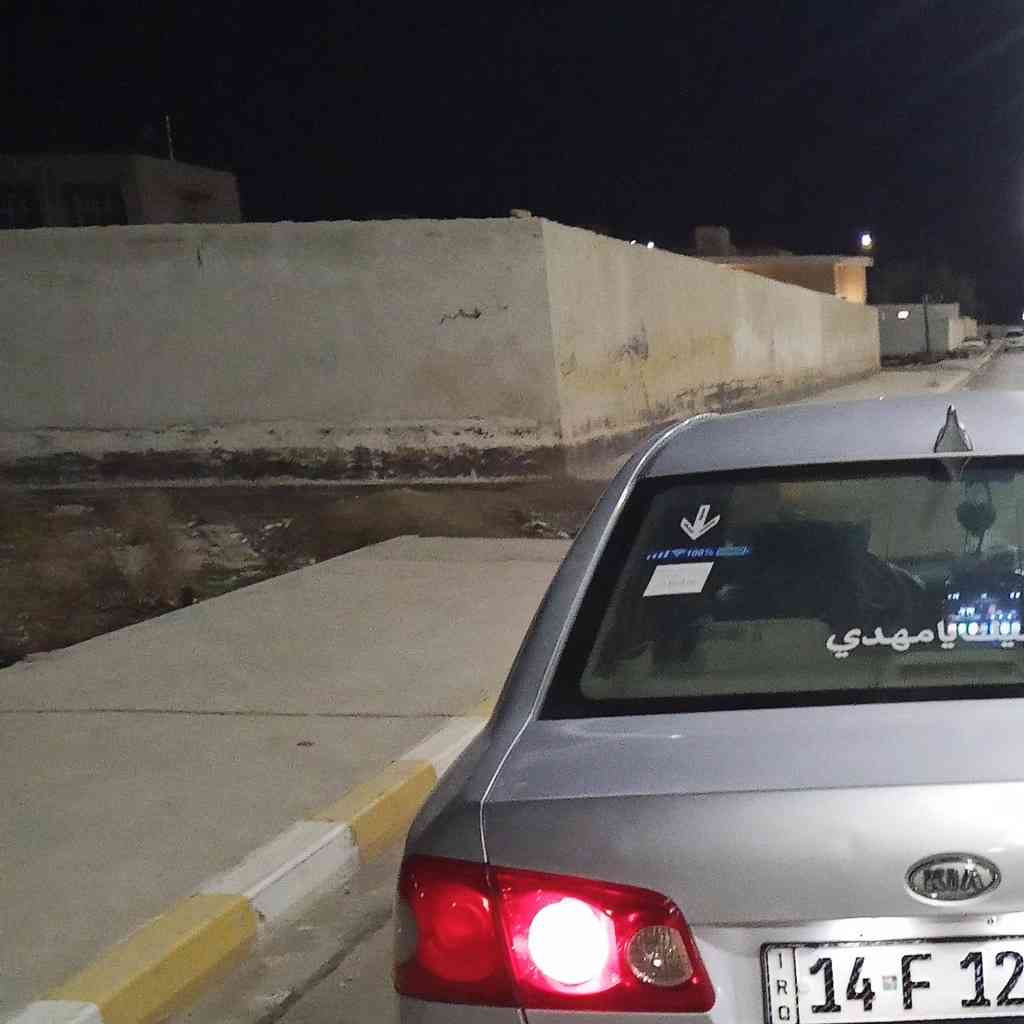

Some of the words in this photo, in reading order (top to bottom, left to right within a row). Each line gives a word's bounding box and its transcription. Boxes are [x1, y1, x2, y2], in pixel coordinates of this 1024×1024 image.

[923, 867, 985, 891] KIA
[775, 952, 791, 1022] IRQ
[808, 955, 876, 1014] 14
[901, 953, 932, 1010] F
